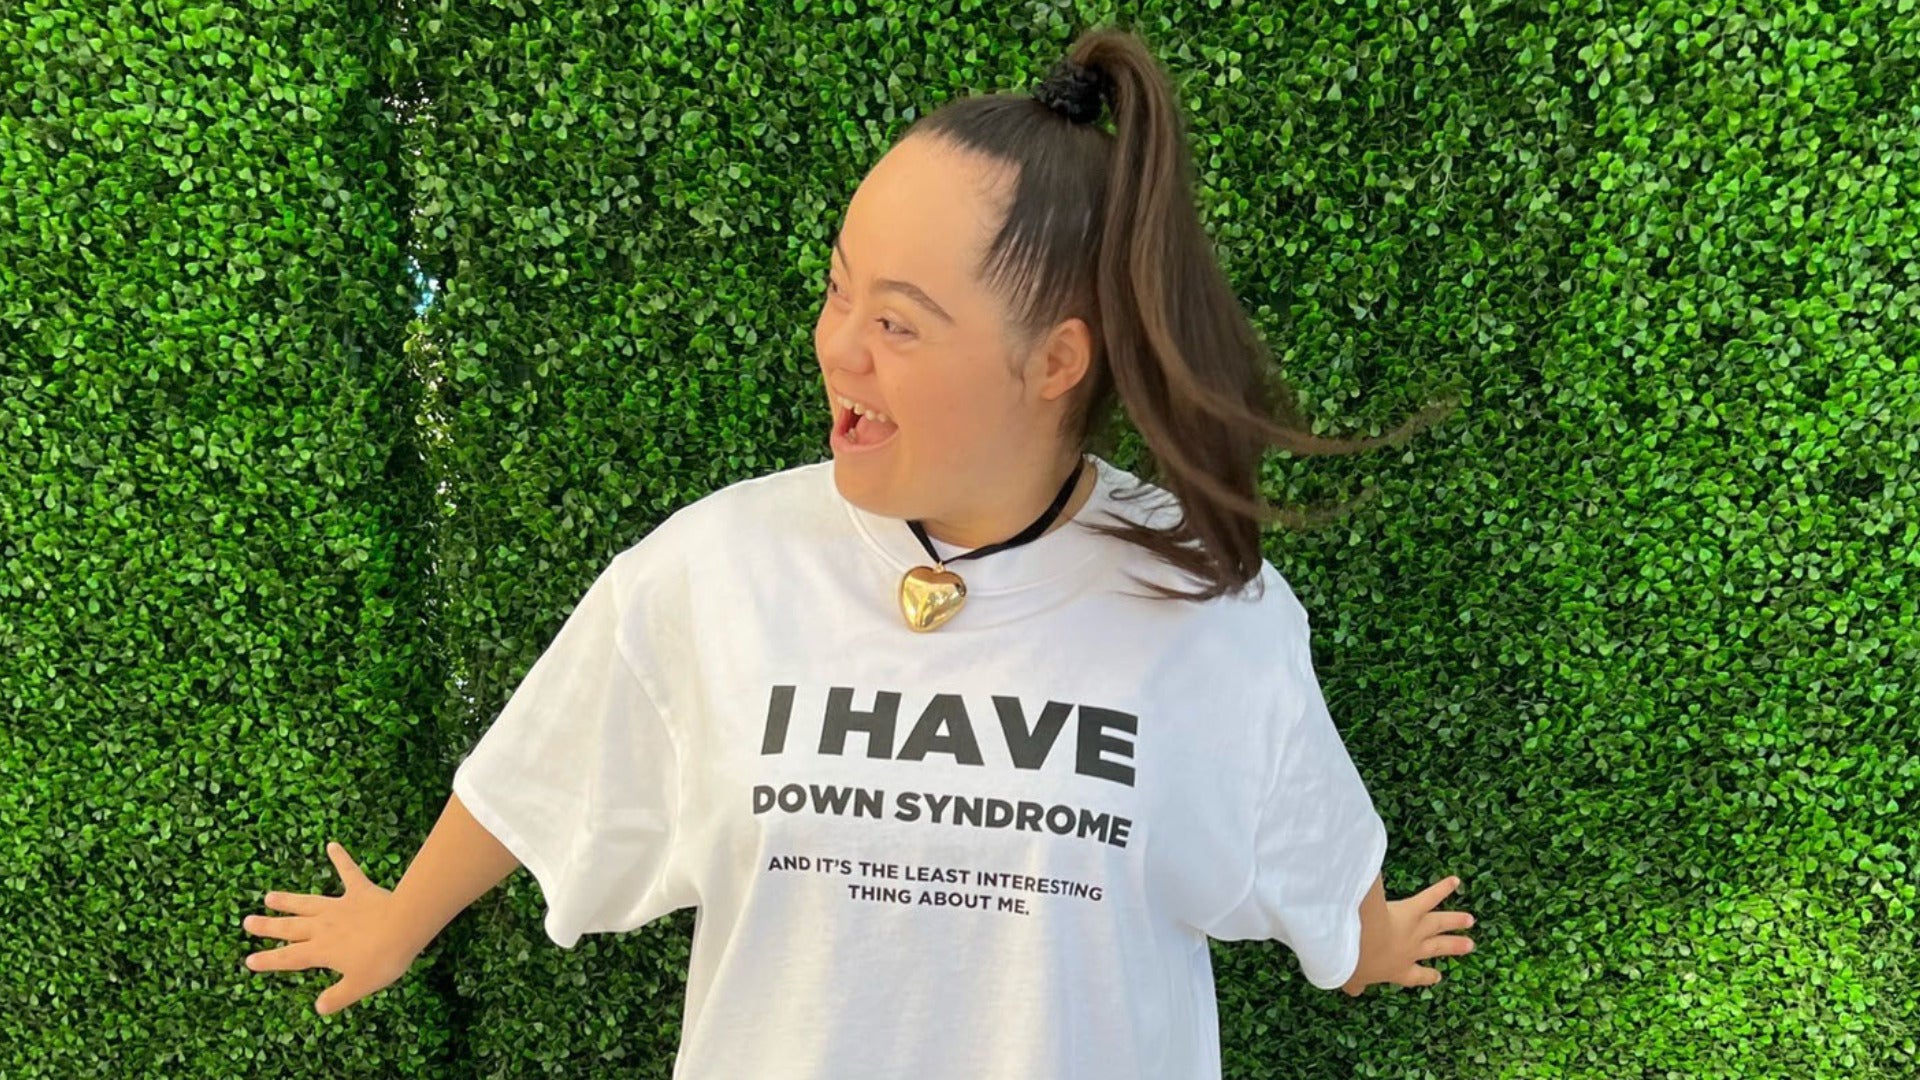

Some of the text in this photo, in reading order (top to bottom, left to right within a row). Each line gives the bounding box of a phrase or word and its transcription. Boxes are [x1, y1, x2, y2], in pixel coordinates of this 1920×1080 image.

[761, 685, 1138, 788] I HAVE
[753, 784, 1132, 849] DOWN SYNDROME
[768, 856, 1102, 902] AND IT'S THE LEAST INTERESTING
[848, 884, 1030, 915] THING ABOUT ME.
